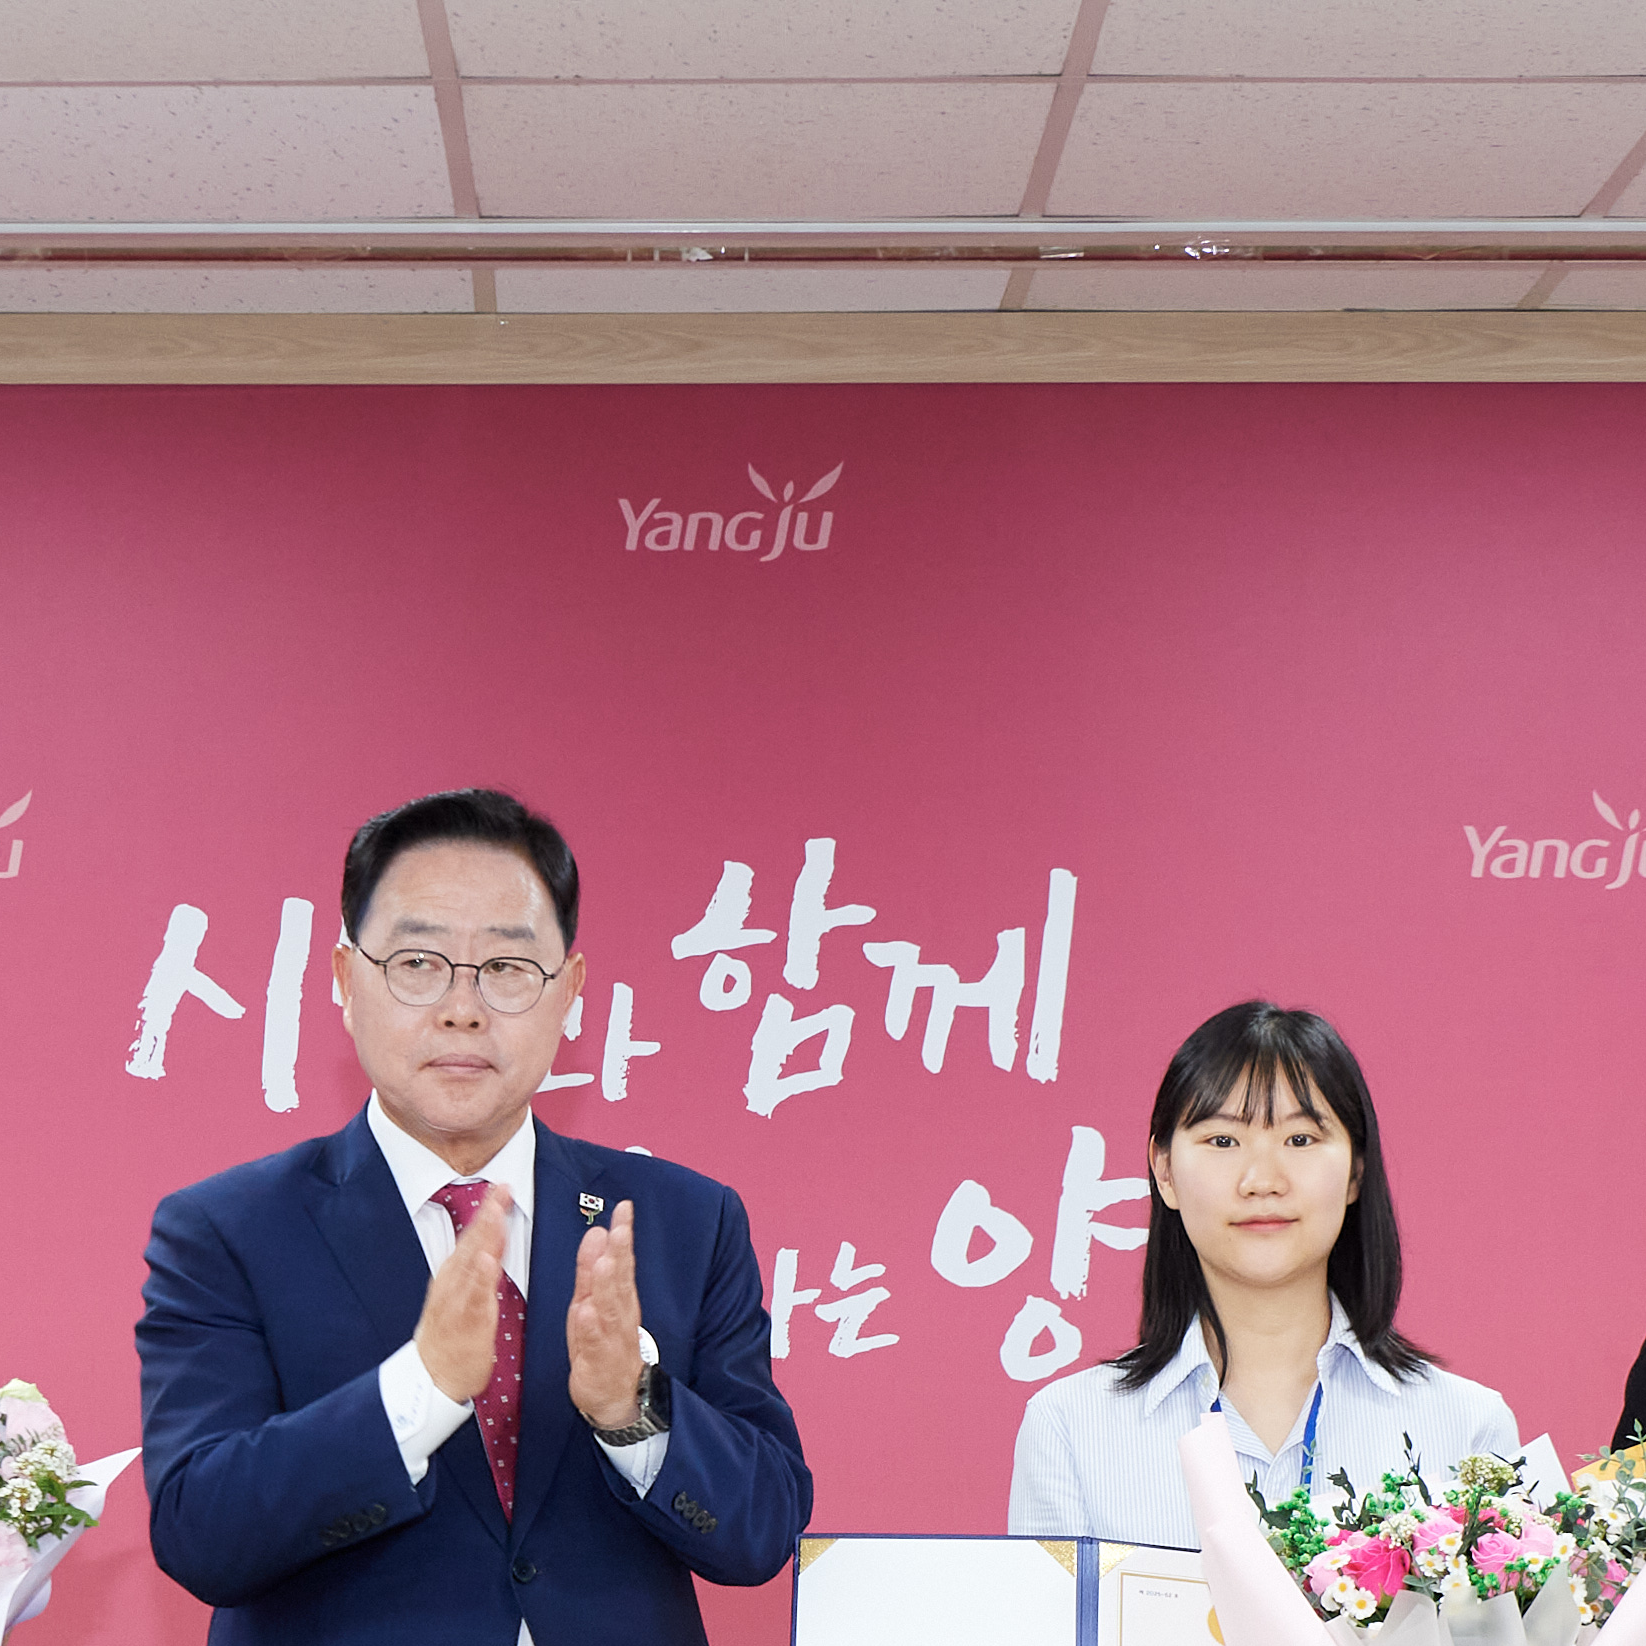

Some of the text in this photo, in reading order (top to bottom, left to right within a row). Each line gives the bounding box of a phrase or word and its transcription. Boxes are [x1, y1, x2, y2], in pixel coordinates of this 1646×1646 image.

[127, 838, 1078, 1116] 시과 함께
[930, 1127, 1148, 1381] 양
